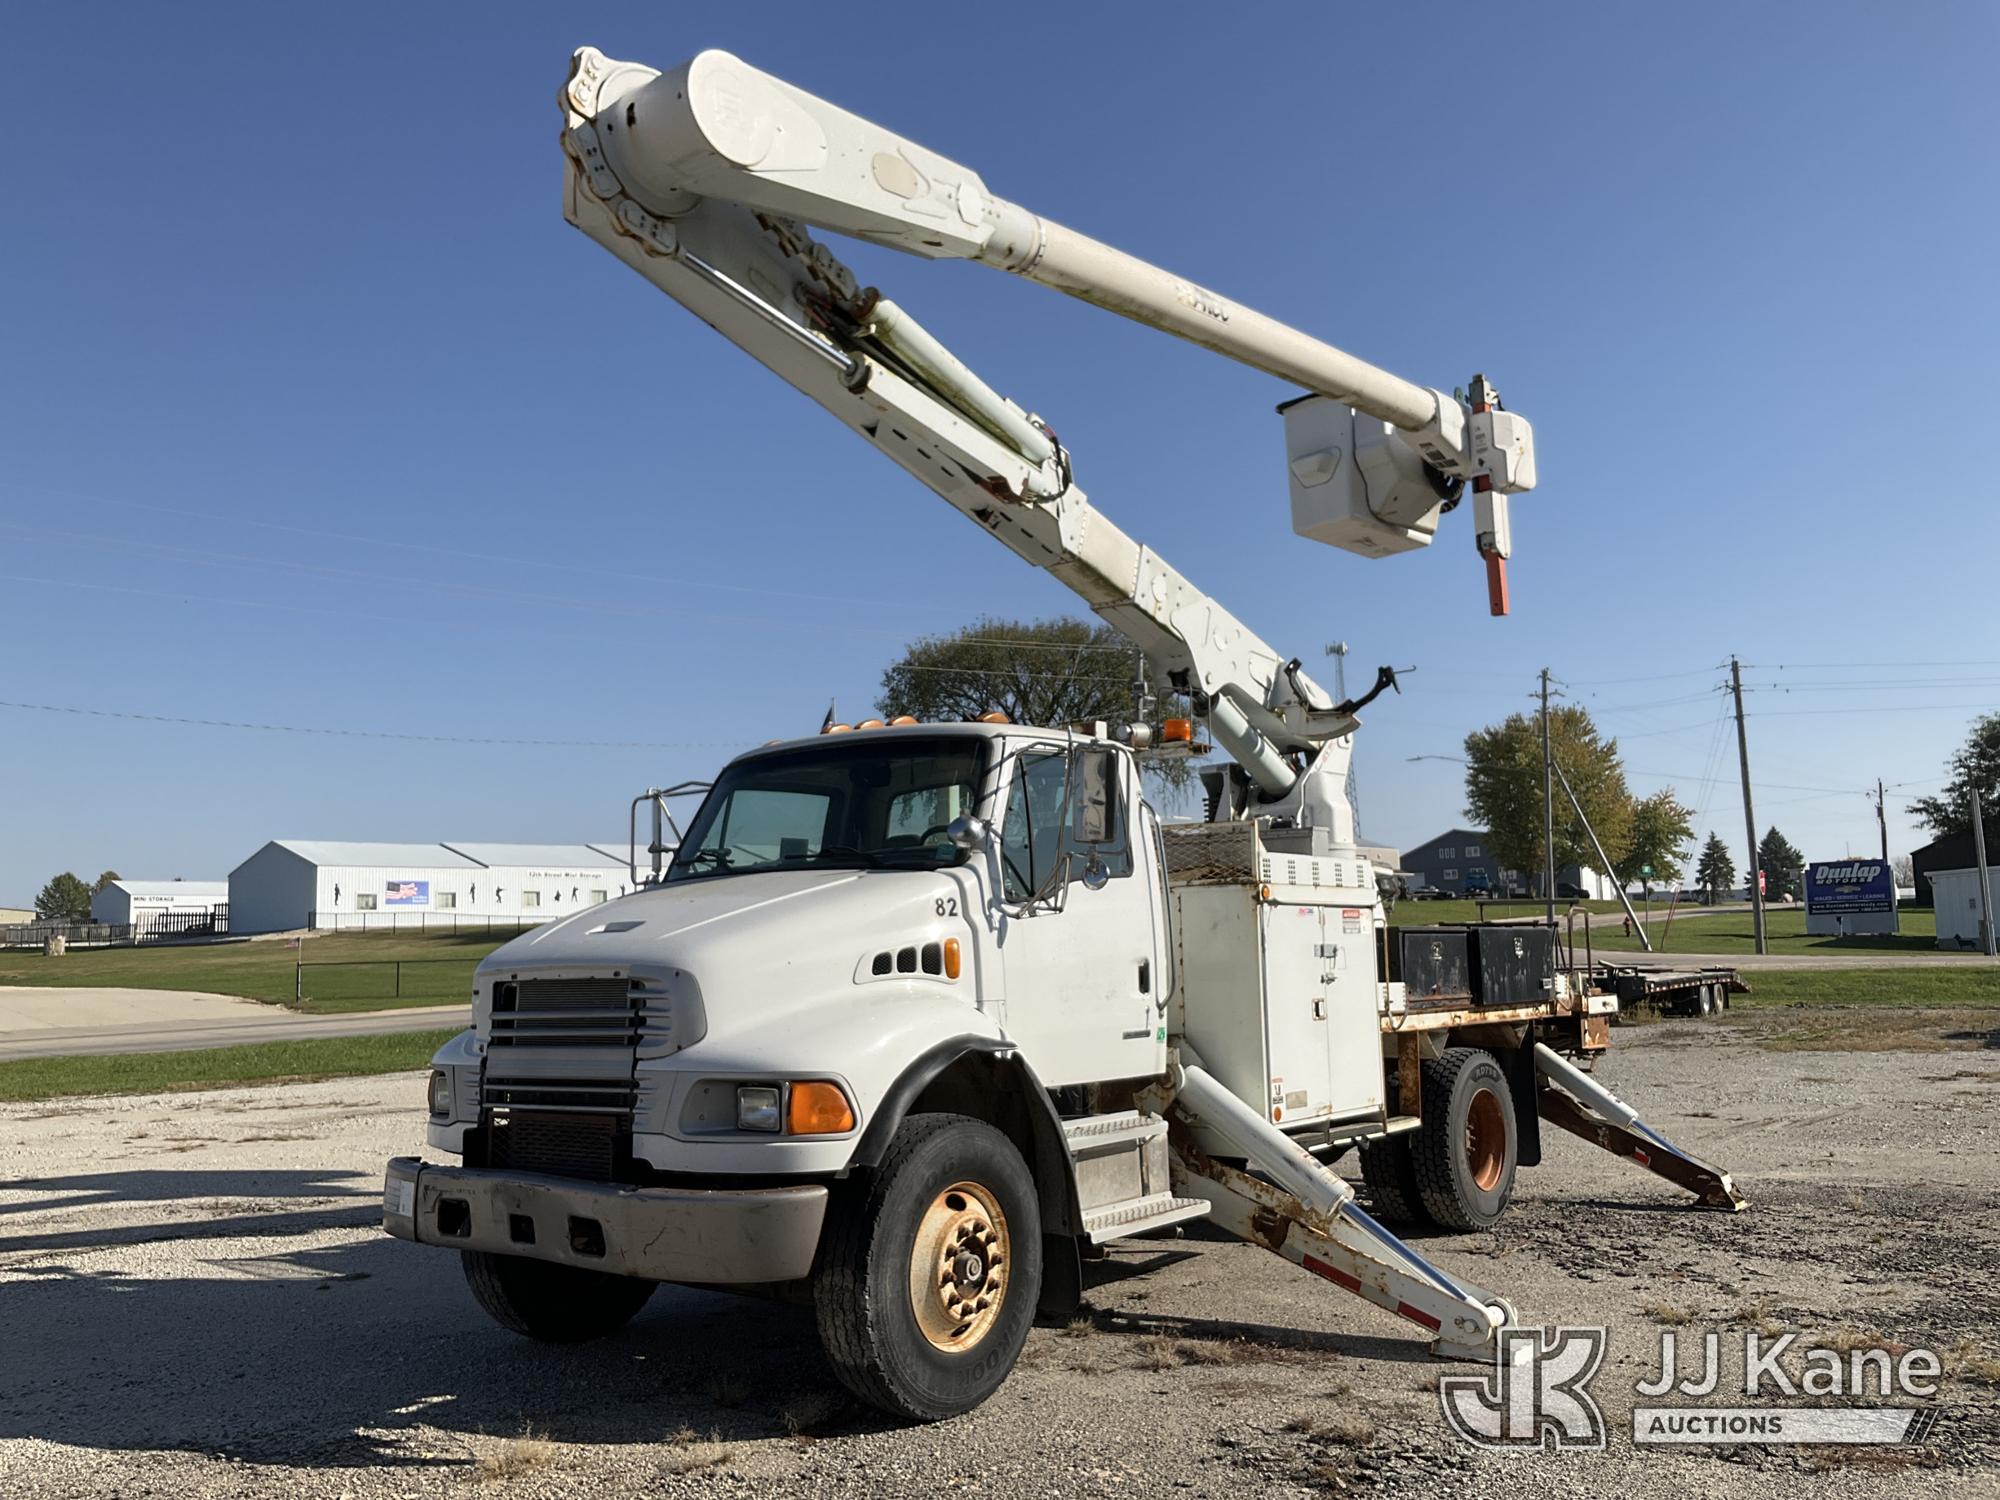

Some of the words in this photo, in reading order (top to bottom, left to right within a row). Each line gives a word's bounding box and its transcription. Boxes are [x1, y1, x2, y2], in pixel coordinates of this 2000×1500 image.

[1815, 863, 1881, 882] Dunlap
[1815, 877, 1866, 885] MOTORS
[935, 897, 958, 917] 82
